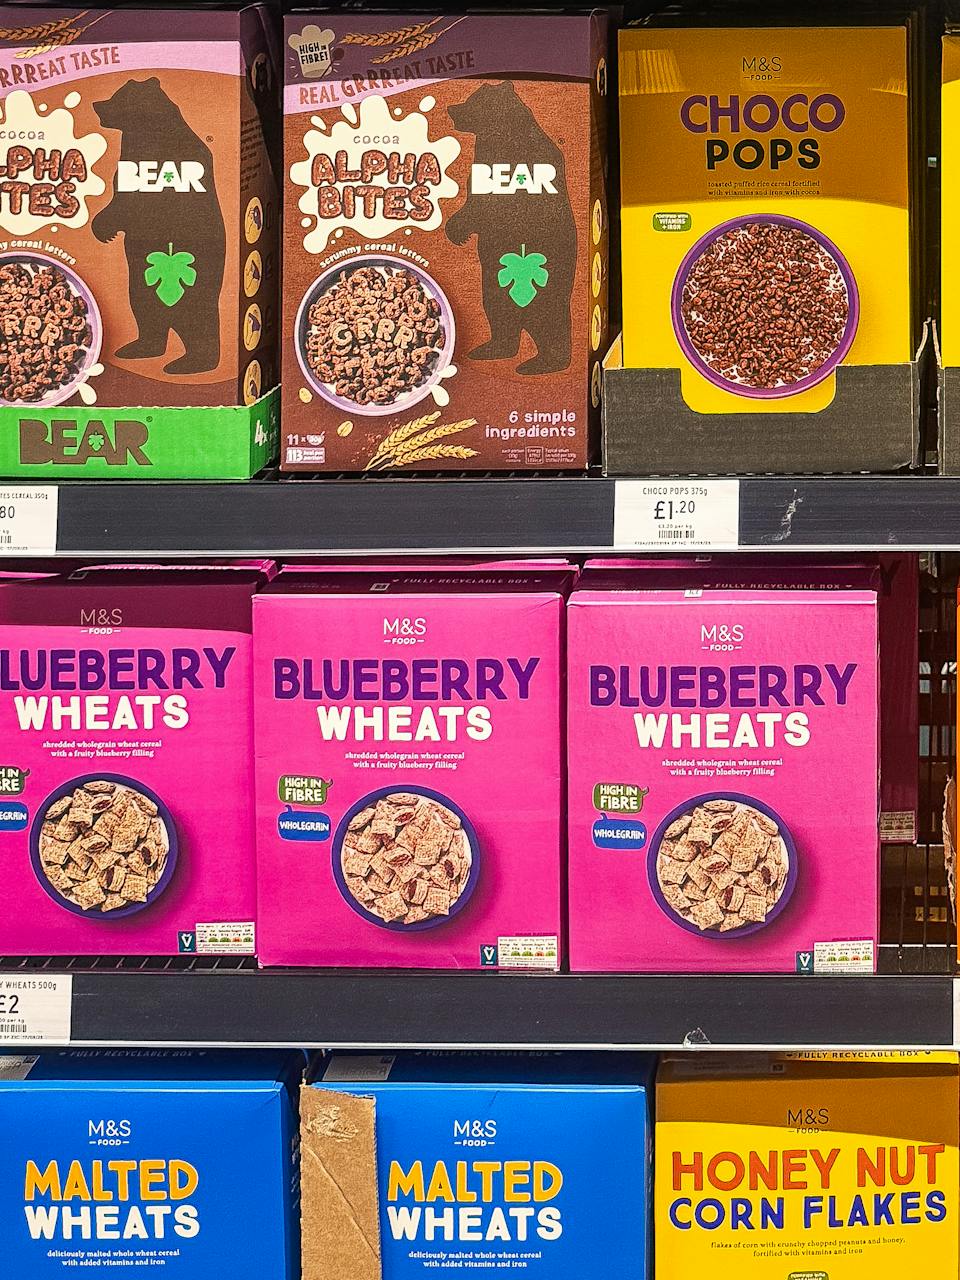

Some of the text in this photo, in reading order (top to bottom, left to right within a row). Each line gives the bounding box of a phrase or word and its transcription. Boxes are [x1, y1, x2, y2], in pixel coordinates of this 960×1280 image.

[300, 44, 320, 54] HIGH
[299, 51, 475, 105] REAL GRRREAT TASTE
[680, 94, 845, 134] CHOCO
[353, 135, 399, 144] cocoa
[706, 139, 821, 171] POPS
[118, 161, 207, 192] BEAR
[311, 151, 441, 185] ALPHA
[471, 164, 558, 195] BEAR
[317, 186, 433, 220] BITES
[320, 243, 429, 267] scrummy cereal letters
[485, 424, 576, 441] ingredients
[509, 409, 576, 426] 6 simple
[20, 418, 153, 466] BEAR
[642, 487, 708, 497] CHOCO POPS 375g
[654, 500, 695, 520] £1.20
[383, 618, 426, 635] M&S
[274, 657, 540, 701] BLUEBERRY
[590, 663, 857, 707] BLUEBERRY
[14, 695, 189, 730] WHEATS
[317, 705, 493, 741] WHEATS
[634, 713, 810, 749] WHEATS
[285, 777, 322, 788] HIGH IN
[285, 788, 322, 802] FIBRE
[280, 821, 329, 831] WHOLEGRAIN
[5, 981, 57, 990] WHEATS 500g
[89, 1120, 130, 1136] M&S
[24, 1160, 198, 1201] MALTED
[672, 1144, 945, 1191] HONEY NUT
[25, 1205, 200, 1240] WHEATS
[669, 1190, 947, 1230] CORN FLAKES
[47, 1250, 84, 1258] deliciously
